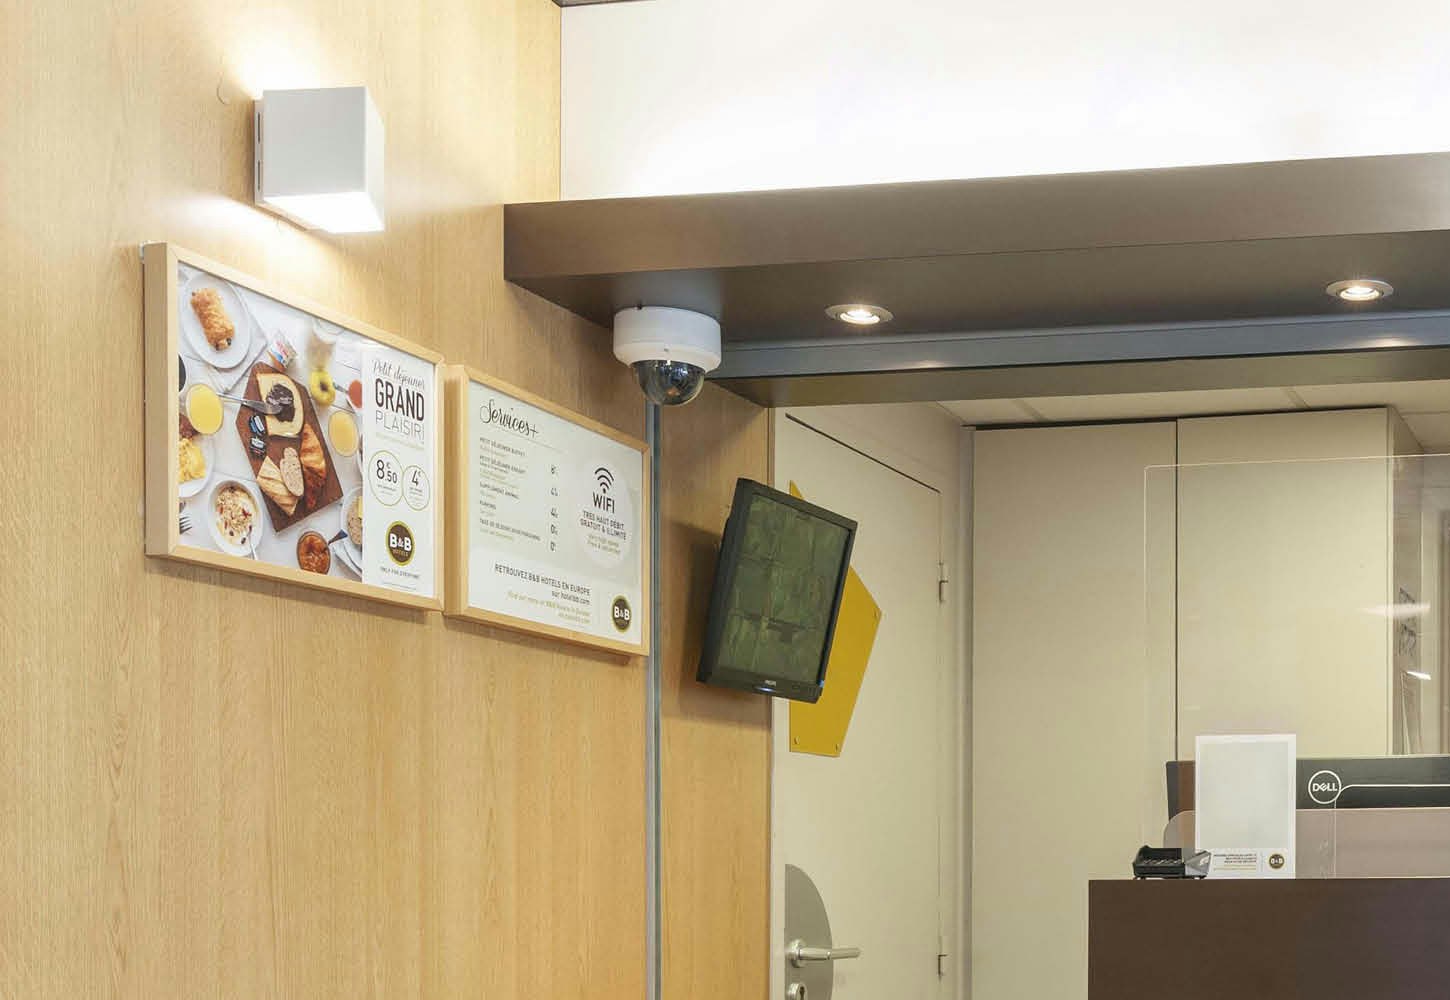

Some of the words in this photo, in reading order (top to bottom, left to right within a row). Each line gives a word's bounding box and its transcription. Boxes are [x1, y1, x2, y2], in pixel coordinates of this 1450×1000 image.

[375, 378, 424, 421] GRAND
[389, 533, 412, 552] B&B
[495, 563, 529, 580] RETROUVEZ
[541, 576, 561, 589] HOTELS
[614, 606, 630, 620] B&B
[1312, 782, 1338, 792] DELL
